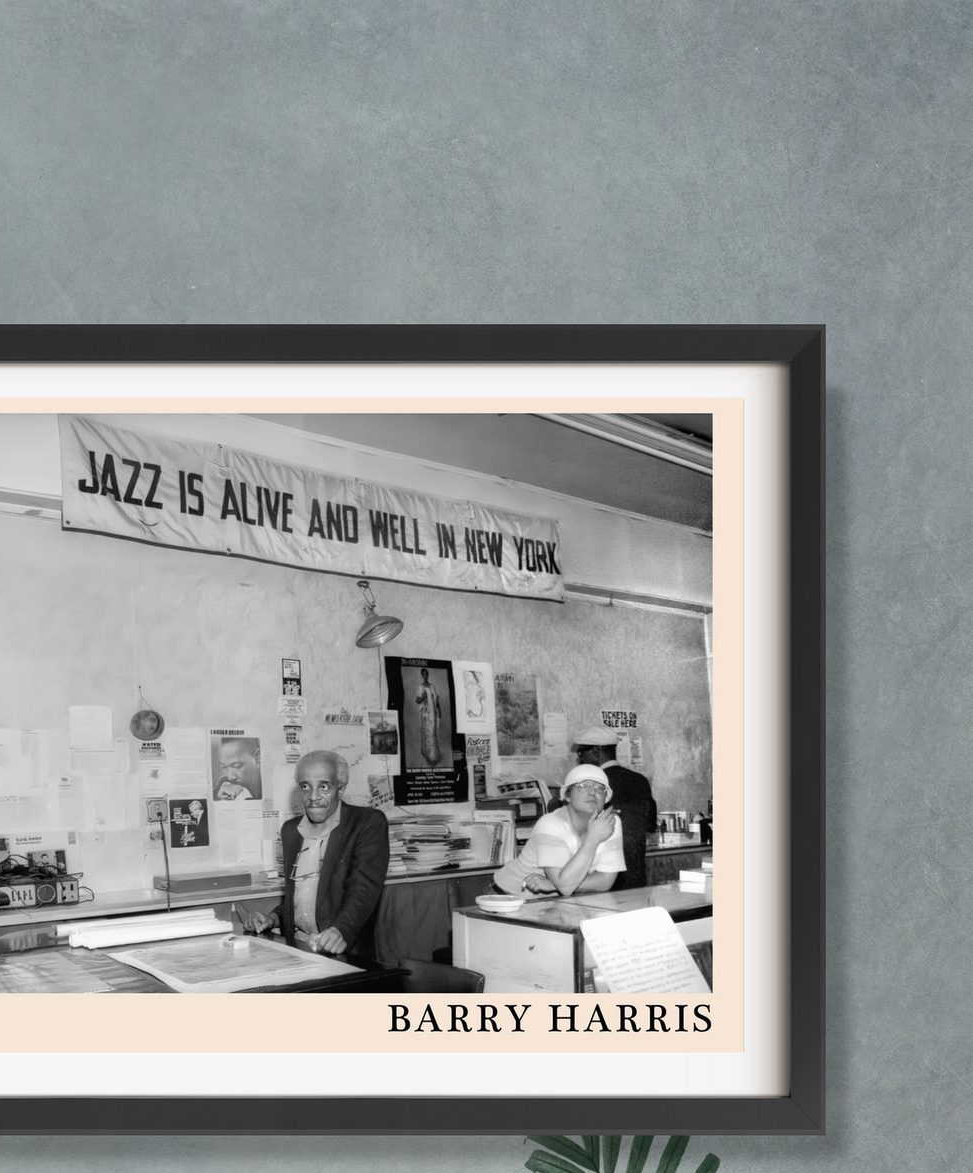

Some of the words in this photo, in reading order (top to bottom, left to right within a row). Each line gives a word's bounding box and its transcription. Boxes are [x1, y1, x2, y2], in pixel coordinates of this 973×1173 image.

[78, 450, 163, 510] JAZZ
[178, 470, 205, 517] IS
[220, 478, 294, 534] ALIVE
[307, 498, 359, 544] AND
[368, 509, 426, 556] WELL
[435, 522, 457, 560] IN
[464, 527, 503, 568] NEW
[512, 536, 562, 576] YORK
[601, 711, 628, 720] TICKETS
[628, 711, 637, 720] ON
[603, 719, 620, 728] SALE
[620, 719, 637, 728] HERE
[467, 737, 490, 746] Posters
[388, 1004, 532, 1033] BARRY
[549, 1004, 712, 1033] HARRIS
